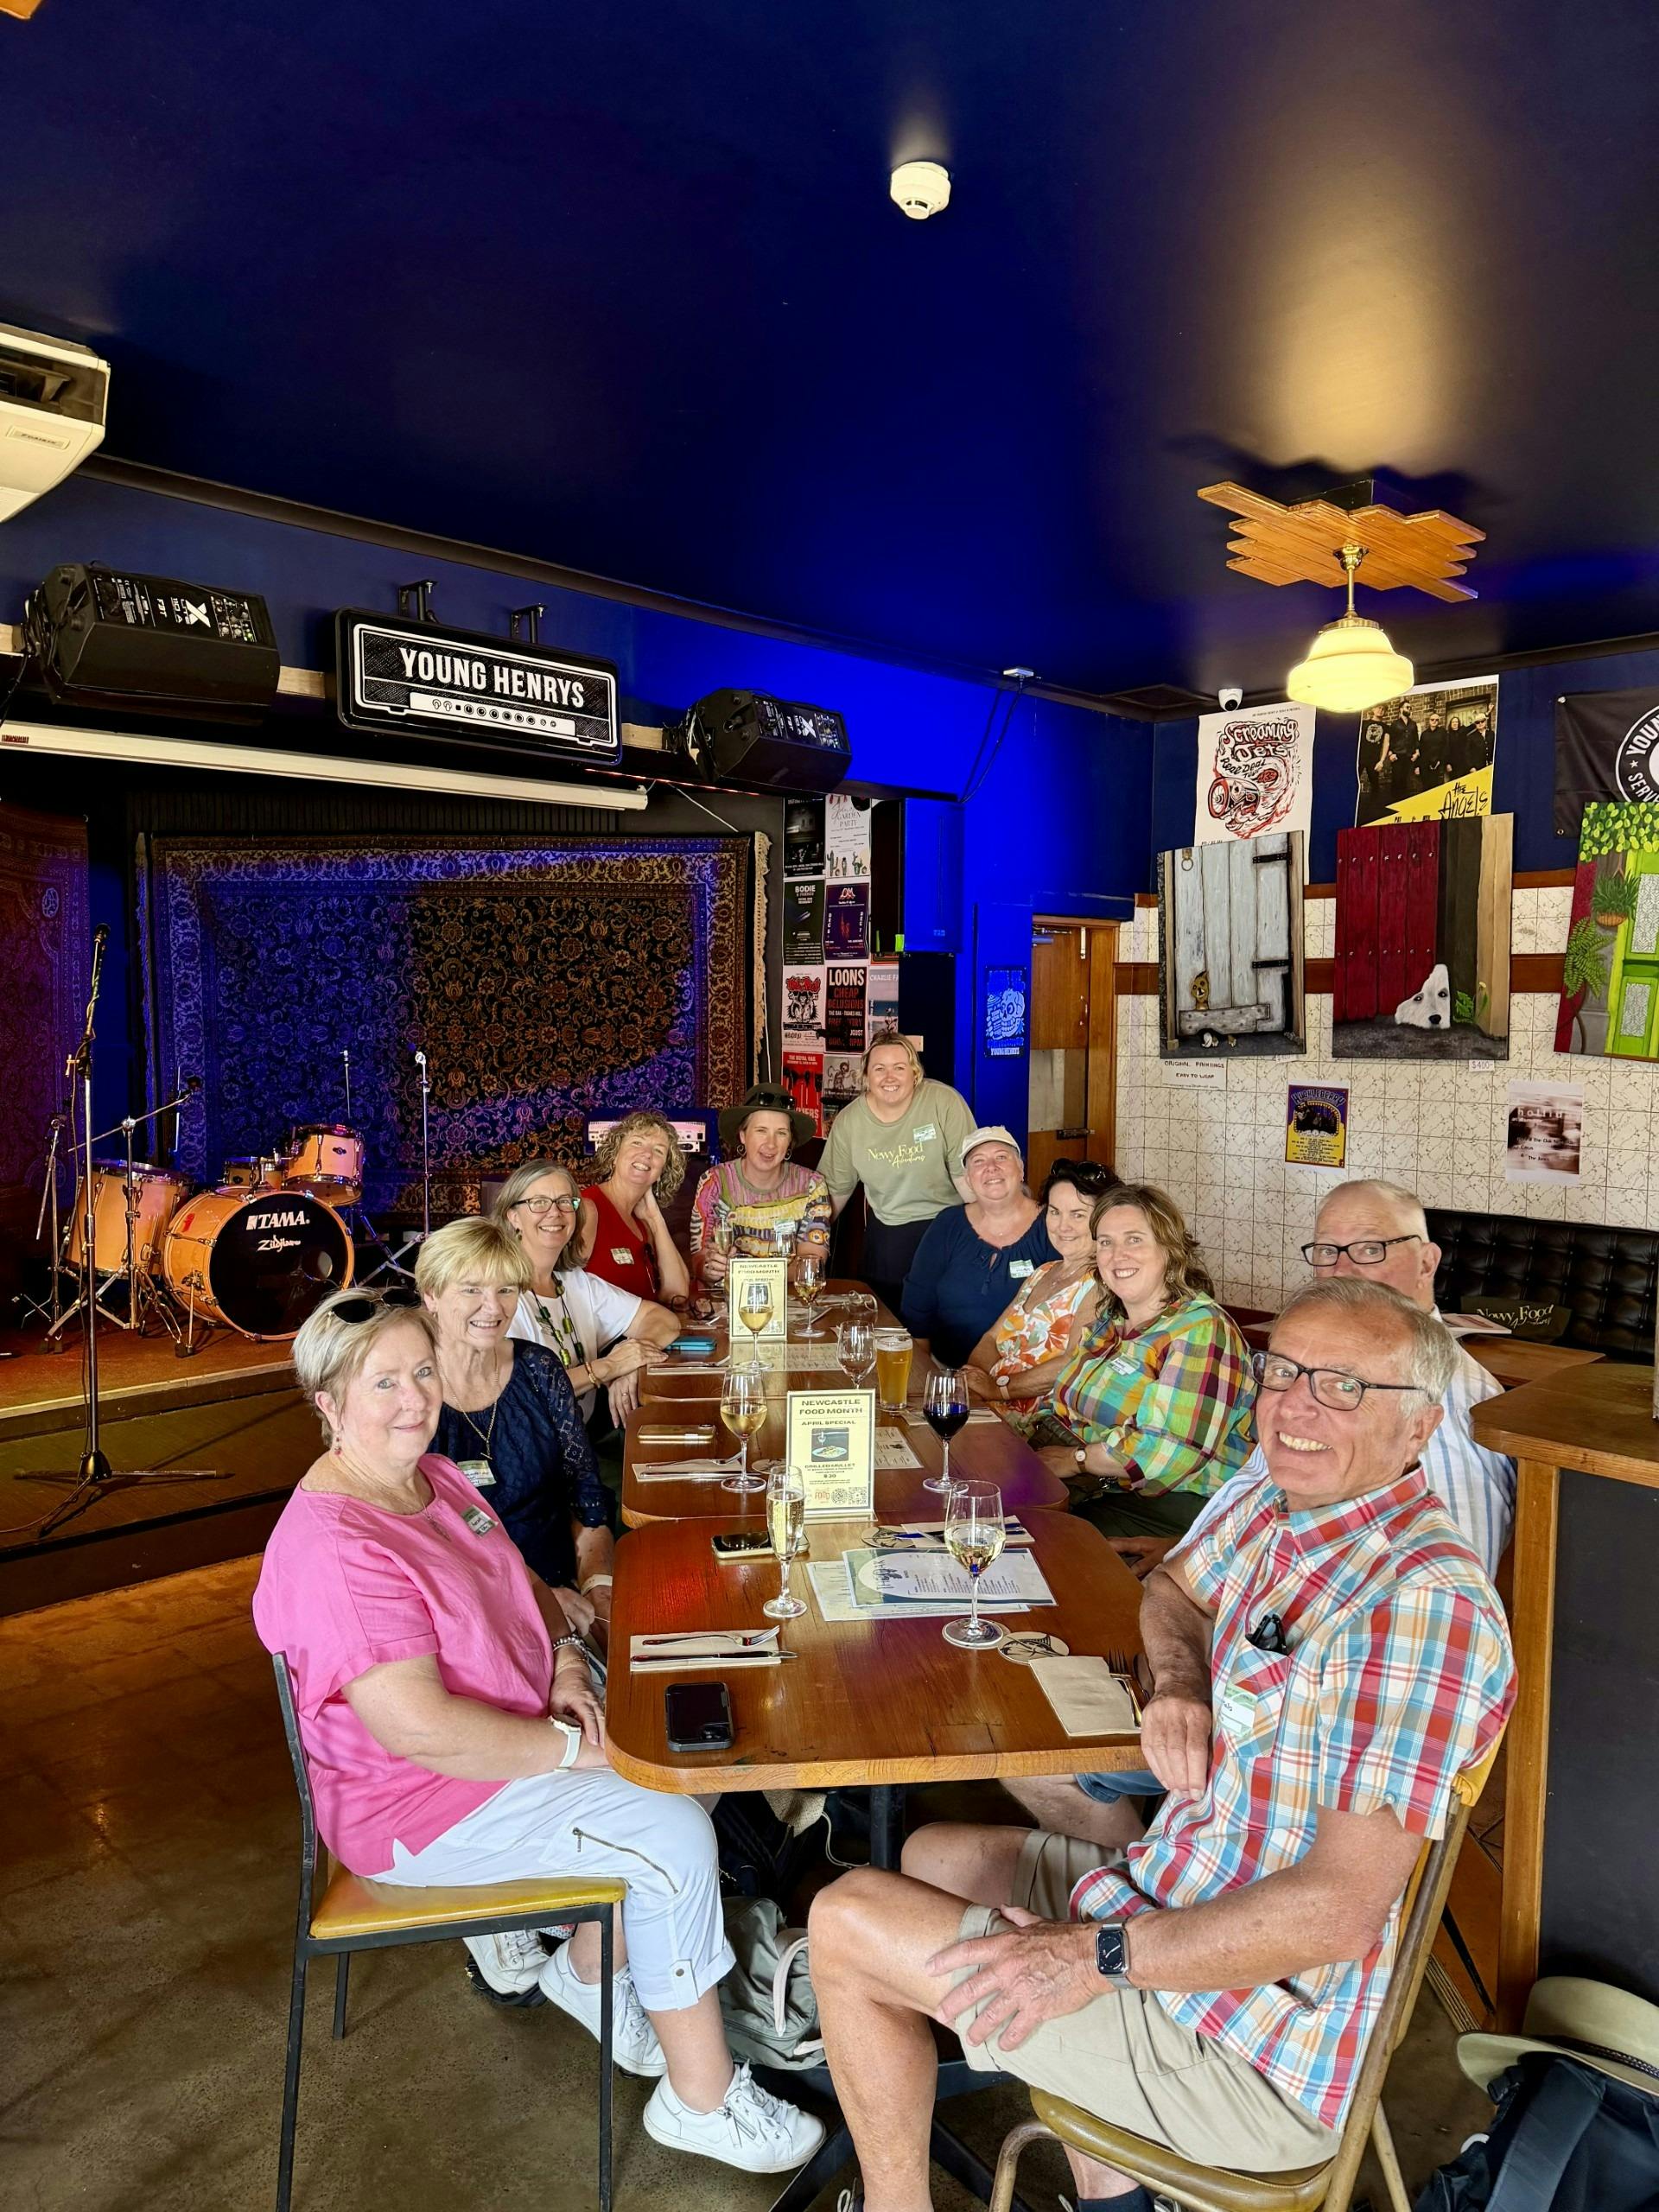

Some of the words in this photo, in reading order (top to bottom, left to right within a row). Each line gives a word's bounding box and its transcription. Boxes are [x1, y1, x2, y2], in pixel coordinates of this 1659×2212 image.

[398, 648, 486, 690] YOUNG
[493, 665, 585, 709] HENRYS
[1219, 719, 1298, 747] Screaming
[1234, 742, 1288, 762] Jets
[795, 885, 816, 893] BODIE
[830, 969, 864, 987] LOONS
[834, 988, 859, 999] CHEAP
[1291, 1090, 1346, 1107] HUCKLEBERRY
[868, 1148, 894, 1161] Newy
[898, 1141, 924, 1157] Food
[257, 1211, 305, 1229] TAMA
[257, 1234, 302, 1252] Zildjian
[1519, 1304, 1554, 1320] Food
